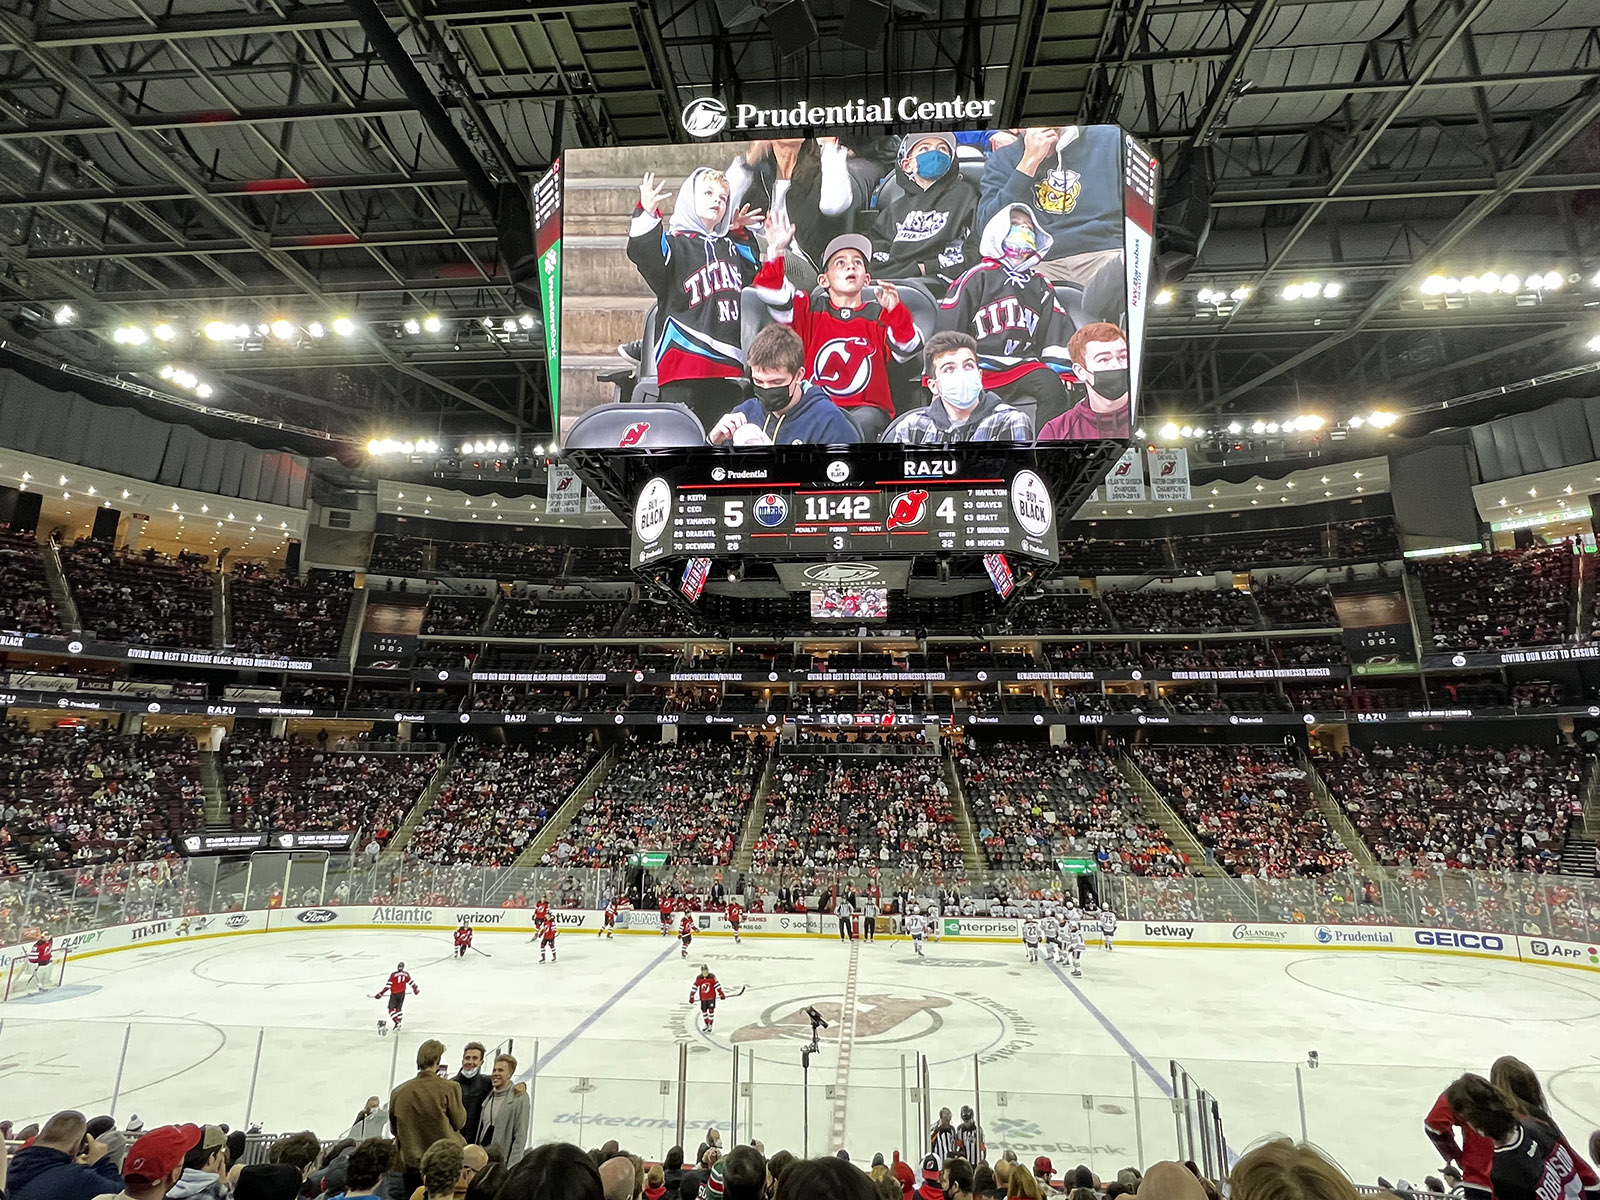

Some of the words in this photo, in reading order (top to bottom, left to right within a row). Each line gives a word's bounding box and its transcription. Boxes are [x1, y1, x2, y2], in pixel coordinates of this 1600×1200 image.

[735, 99, 893, 128] Prudential
[898, 95, 995, 121] Center
[718, 300, 739, 321] NJ
[727, 469, 767, 479] Prudential
[904, 460, 956, 475] RAZU
[724, 501, 743, 528] 5
[805, 496, 871, 520] 11:42
[935, 497, 956, 524] 4
[1019, 500, 1046, 523] BLACK
[641, 507, 664, 529] BLACK
[833, 537, 844, 550] 3
[941, 540, 953, 548] 32
[373, 644, 403, 653] 1982
[1361, 637, 1396, 647] 1982
[128, 649, 149, 659] GIVING
[150, 650, 163, 659] OUR
[164, 651, 180, 661] BEST
[181, 653, 189, 662] TO
[189, 653, 212, 664] ENSURE
[213, 655, 253, 666] BLACK-OWNED
[254, 658, 287, 669] BUSINESSES
[288, 660, 313, 670] SUCCEED
[1501, 653, 1525, 664] GIVING
[1525, 652, 1541, 662] OUR
[1541, 651, 1559, 660] BEST
[1561, 650, 1570, 659] TO
[1571, 648, 1600, 658] ENSURE
[81, 681, 110, 690] LAGER
[0, 695, 16, 704] ZU
[207, 705, 236, 714] RAZU
[504, 715, 526, 723] RAZU
[657, 715, 678, 723] RAZU
[1079, 715, 1103, 723] RAZU
[1357, 713, 1387, 722] RAZU
[302, 910, 332, 923] Ford
[372, 907, 432, 922] Atlantic
[457, 911, 499, 924] verizon
[551, 912, 585, 926] etway
[950, 922, 1017, 935] enterprise
[1144, 924, 1194, 939] betway
[1335, 930, 1393, 943] Prudential
[1415, 931, 1504, 951] GEICO
[553, 1112, 748, 1131] ticketmaster
